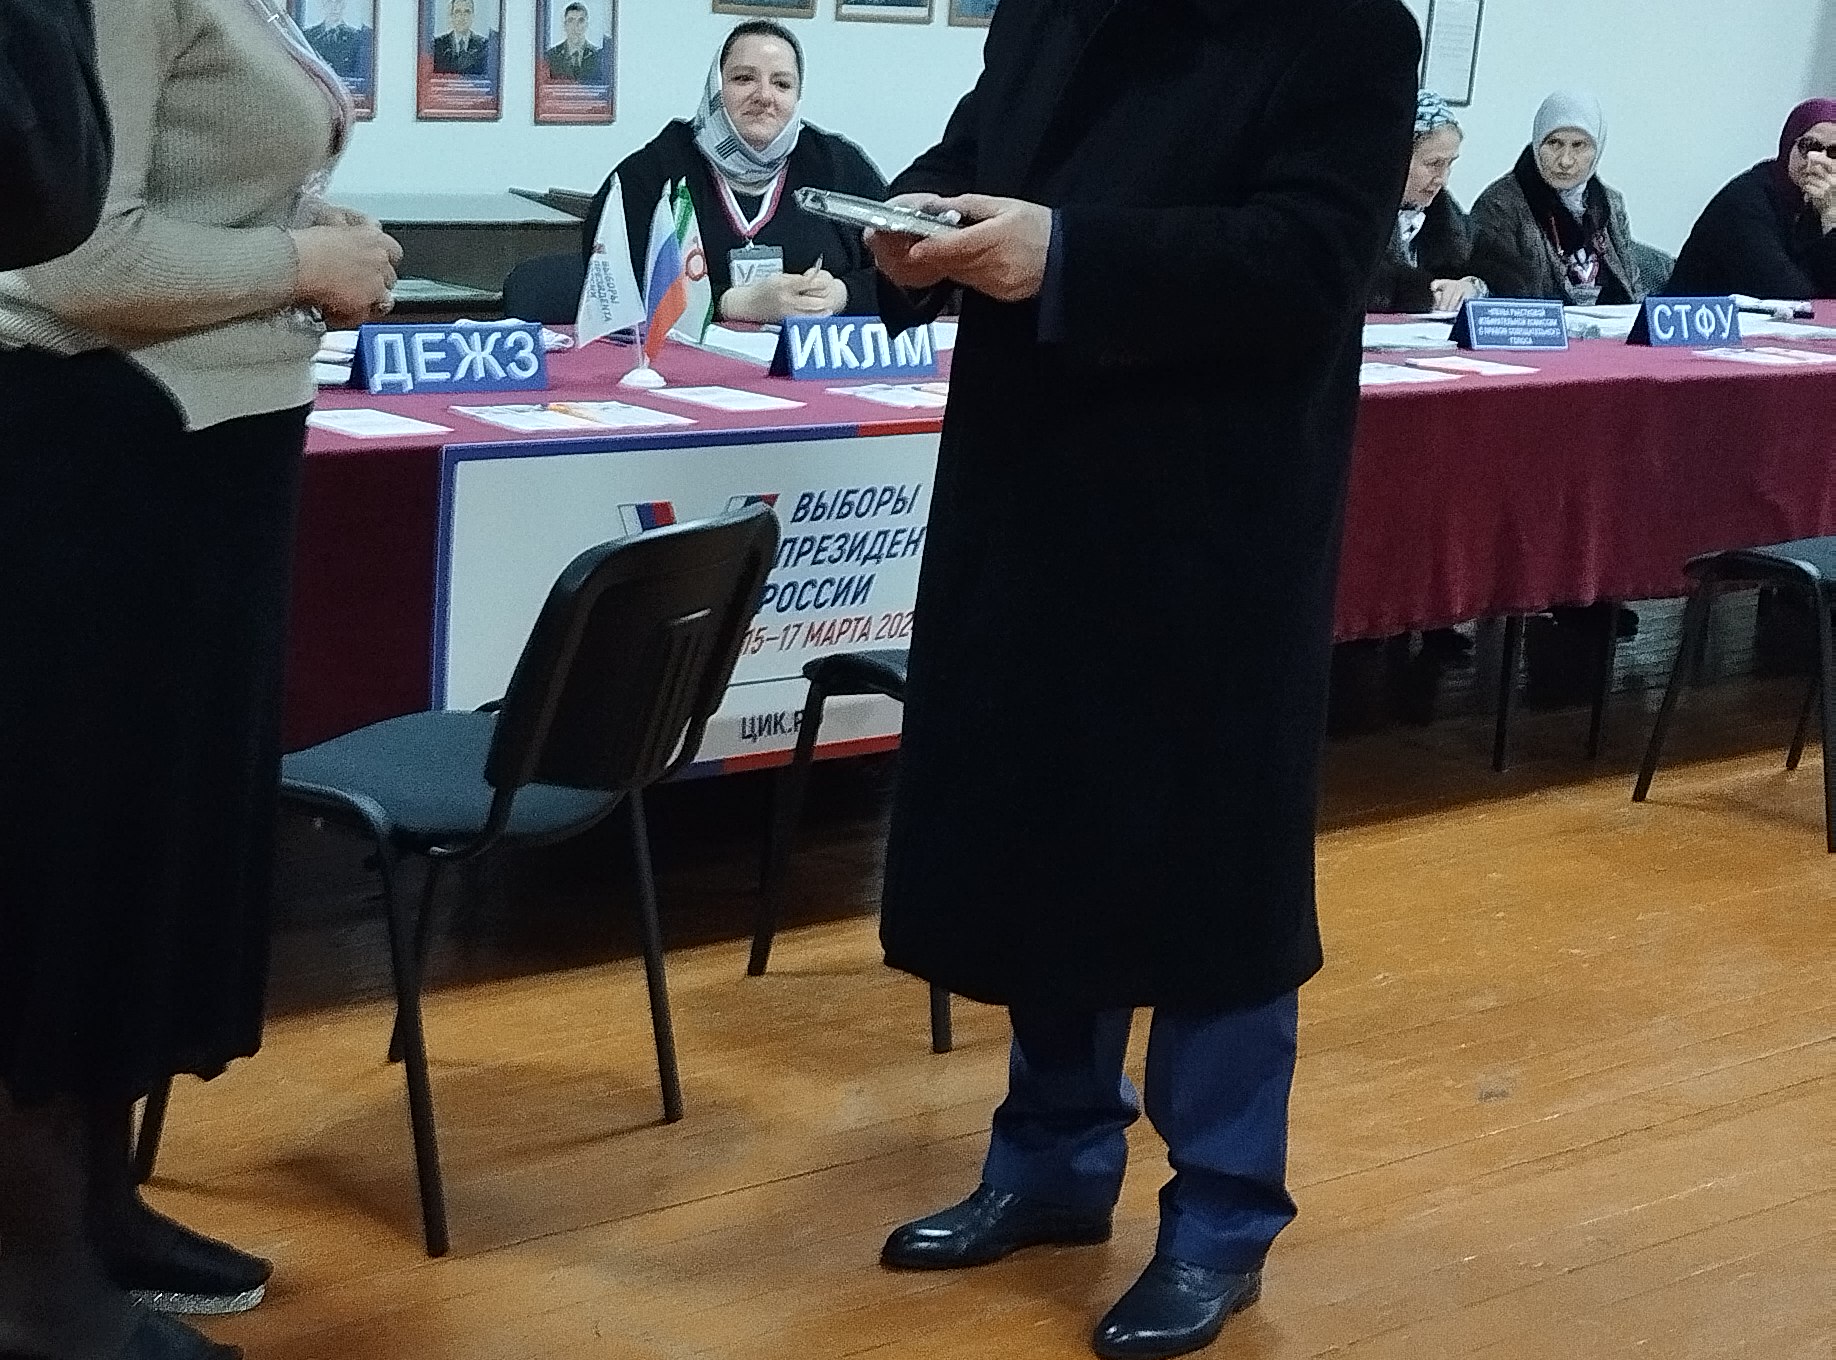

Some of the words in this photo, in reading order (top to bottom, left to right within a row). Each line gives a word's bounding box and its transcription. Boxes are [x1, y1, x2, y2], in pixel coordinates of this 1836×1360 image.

[1652, 301, 1736, 340] СТФУ
[370, 330, 540, 393] ДЕЖЗ
[790, 322, 933, 370] ИКЛМ
[791, 483, 922, 524] ВЫБОРЫ
[760, 573, 877, 614] РОССИИ
[802, 615, 872, 649] МАРТА
